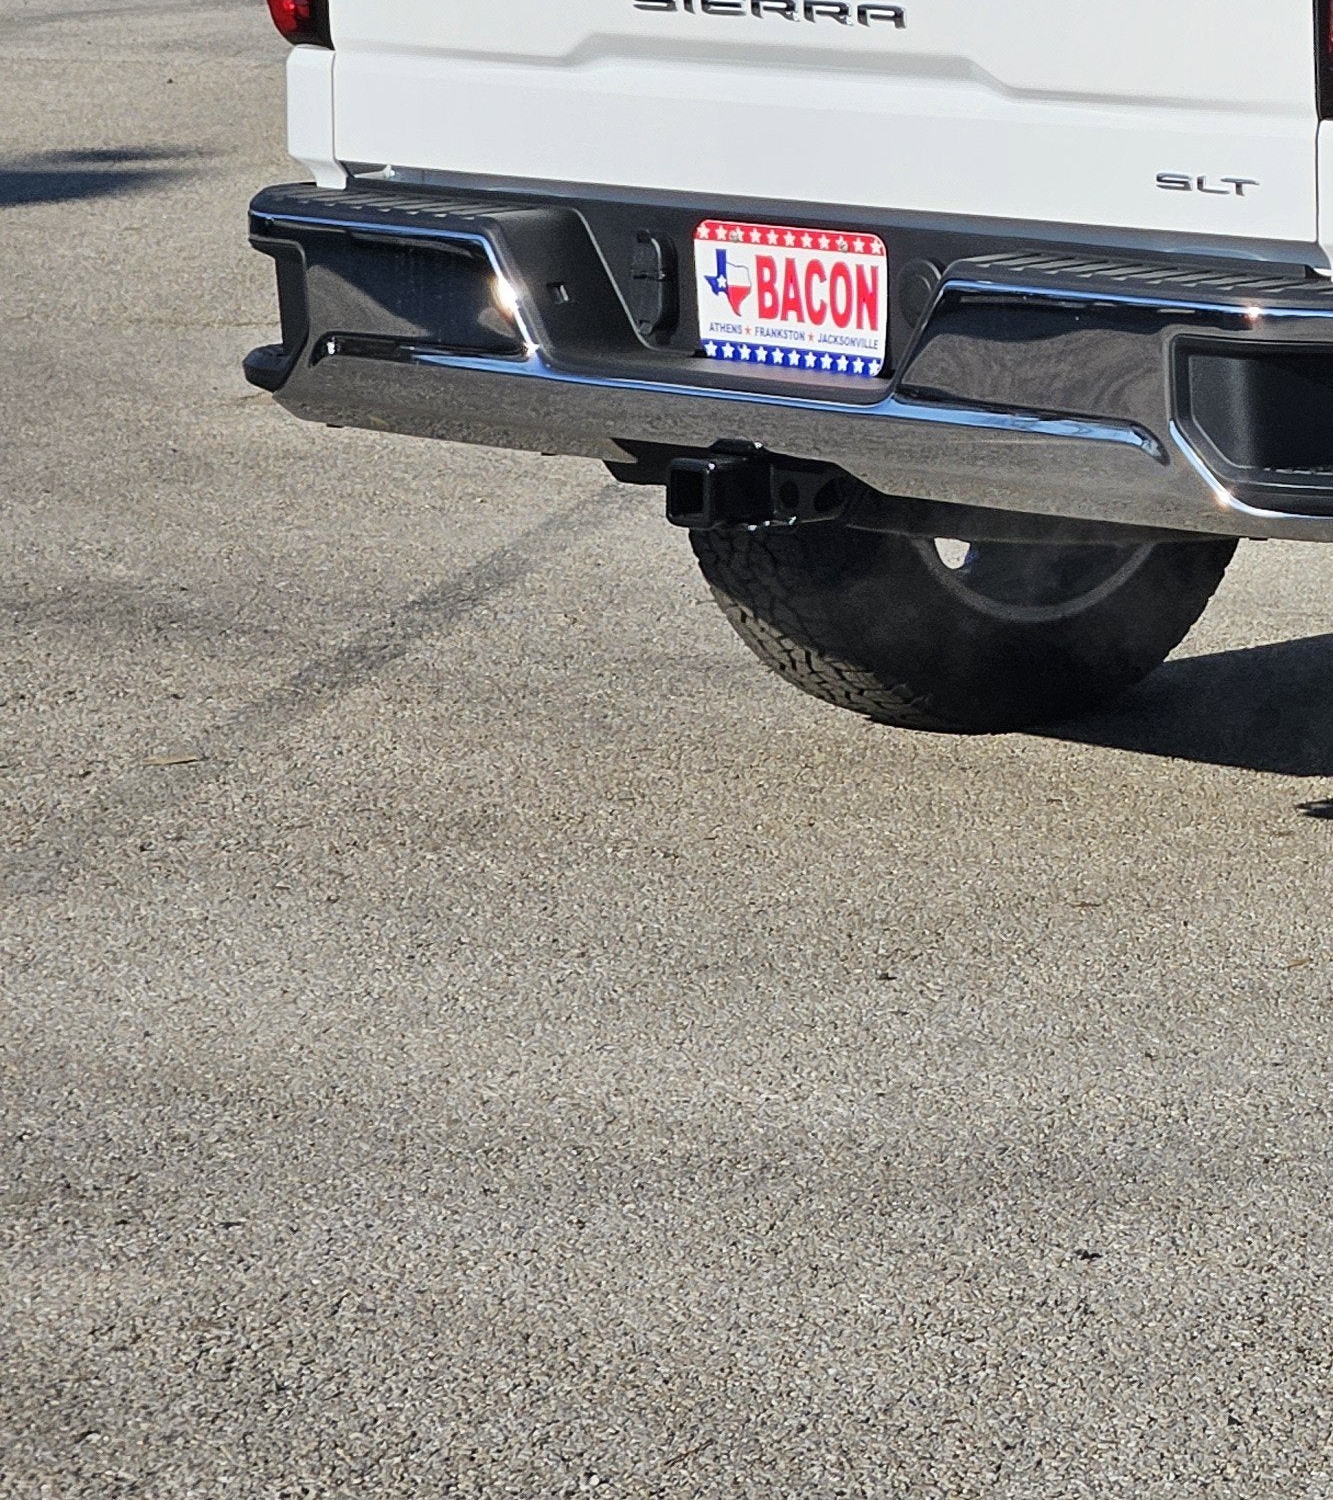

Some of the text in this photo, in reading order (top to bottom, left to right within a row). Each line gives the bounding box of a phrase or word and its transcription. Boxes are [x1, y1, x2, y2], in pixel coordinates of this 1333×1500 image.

[1155, 171, 1260, 197] SLT
[755, 254, 879, 331] BACON
[708, 322, 879, 350] ATHENS FRANKSTON JACKSONVILLE
